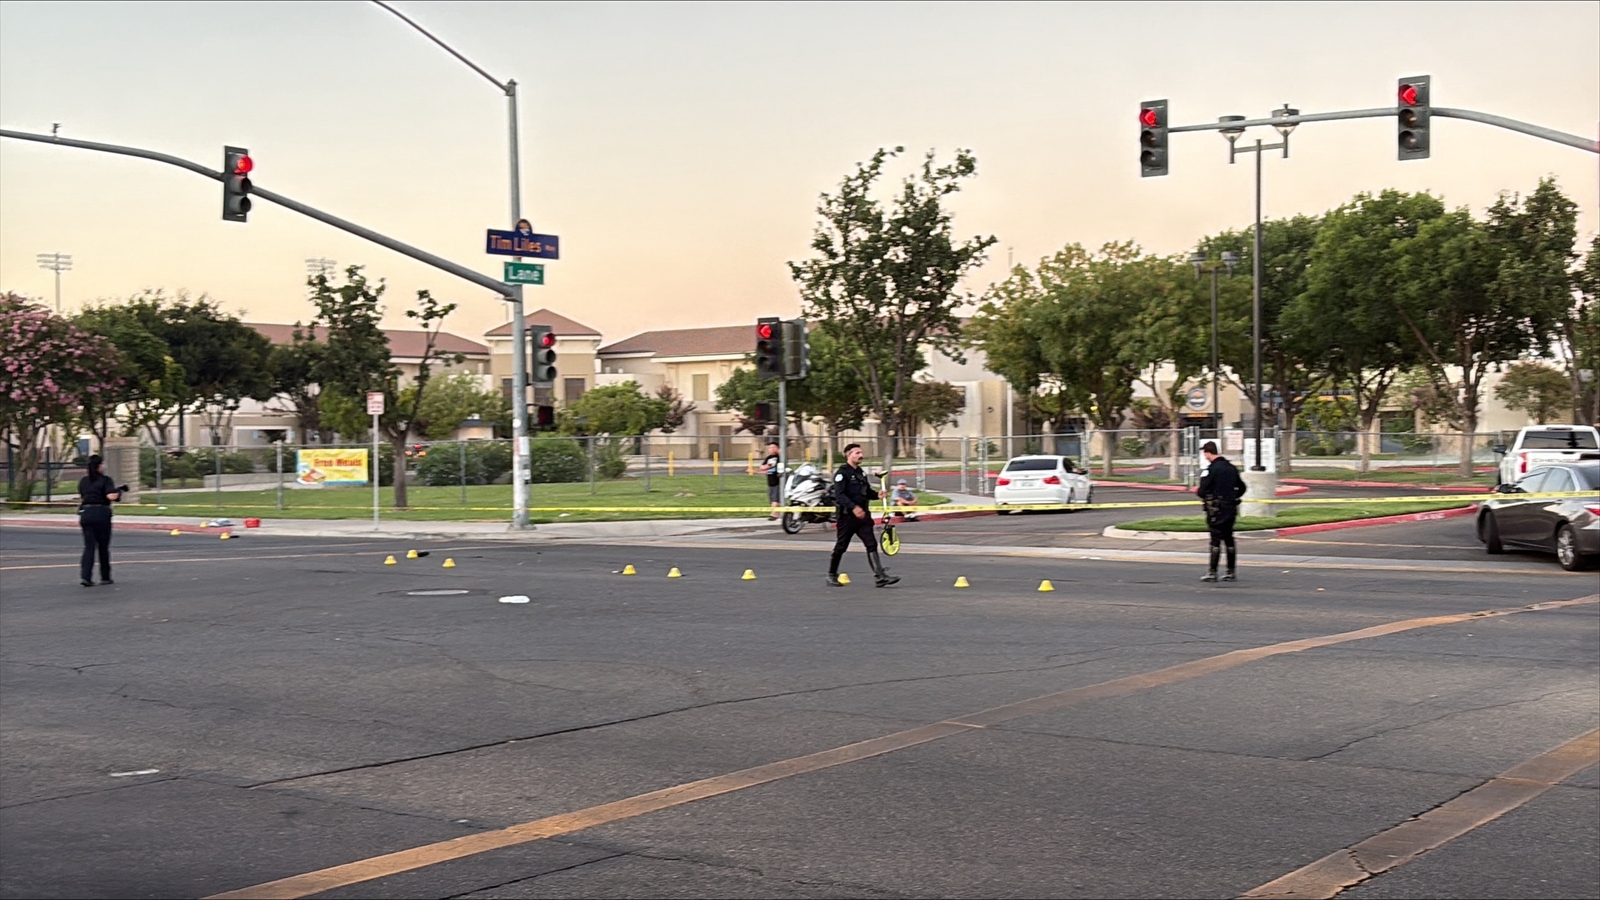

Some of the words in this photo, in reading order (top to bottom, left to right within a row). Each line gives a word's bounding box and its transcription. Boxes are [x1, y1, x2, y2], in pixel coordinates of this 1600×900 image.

[490, 235, 512, 250] Tim
[513, 237, 542, 253] Liles
[508, 266, 541, 281] Lane
